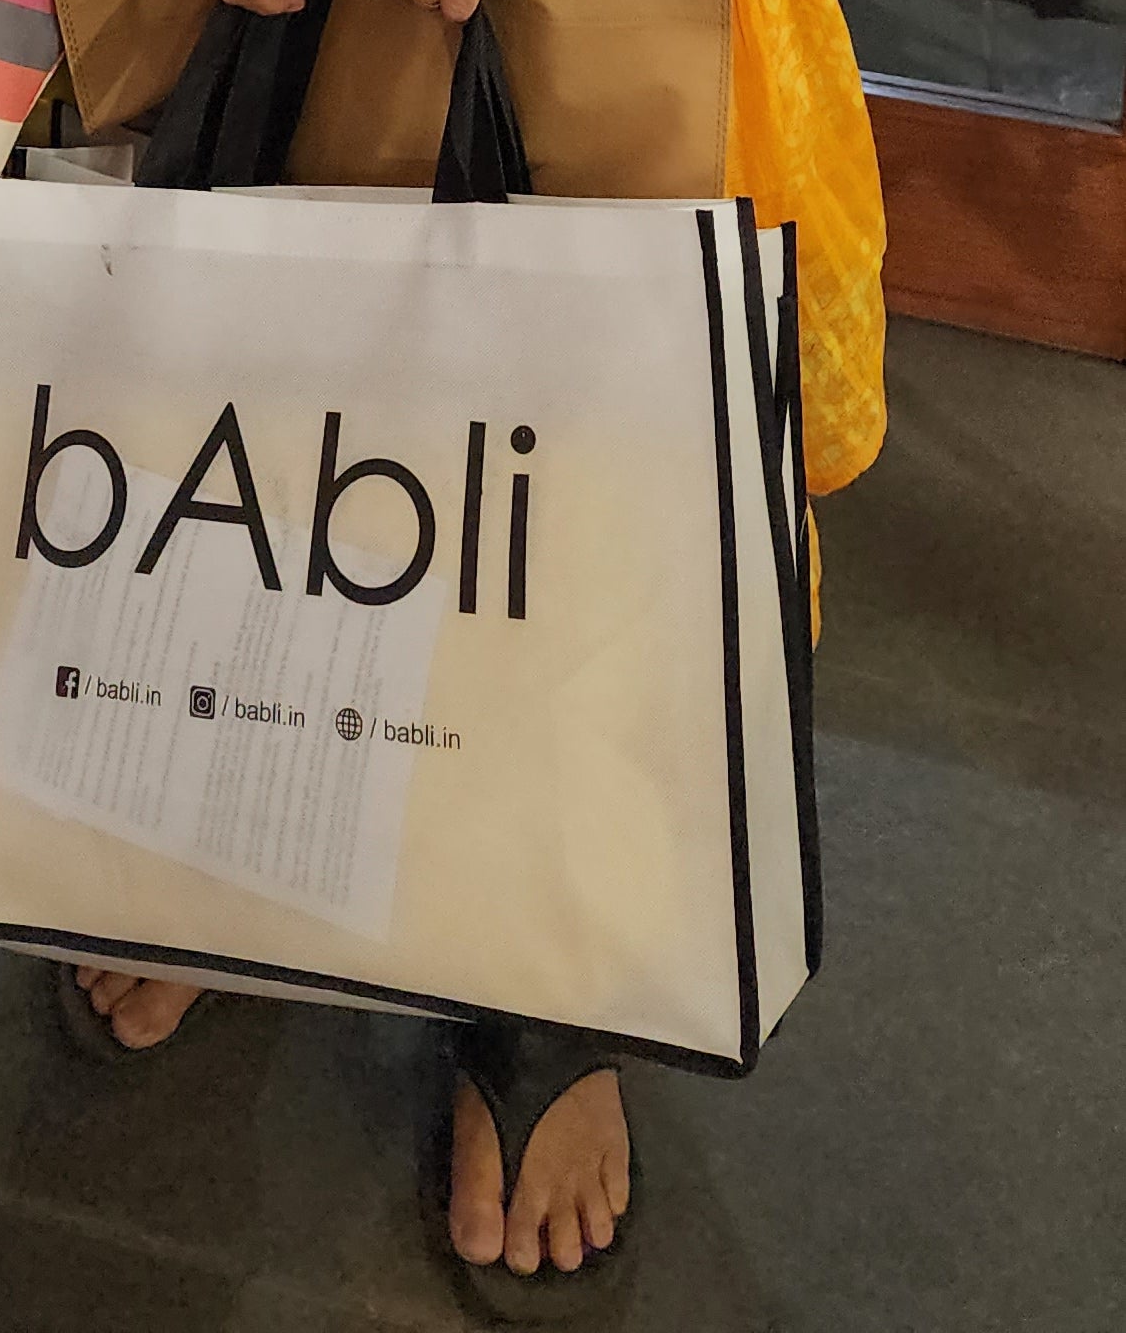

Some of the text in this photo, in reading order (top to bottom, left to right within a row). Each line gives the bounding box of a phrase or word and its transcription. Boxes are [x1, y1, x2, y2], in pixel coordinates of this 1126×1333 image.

[15, 383, 537, 620] bAbli
[96, 676, 161, 707] babli.in
[234, 696, 305, 729] babli.in
[384, 719, 461, 750] babli.in
